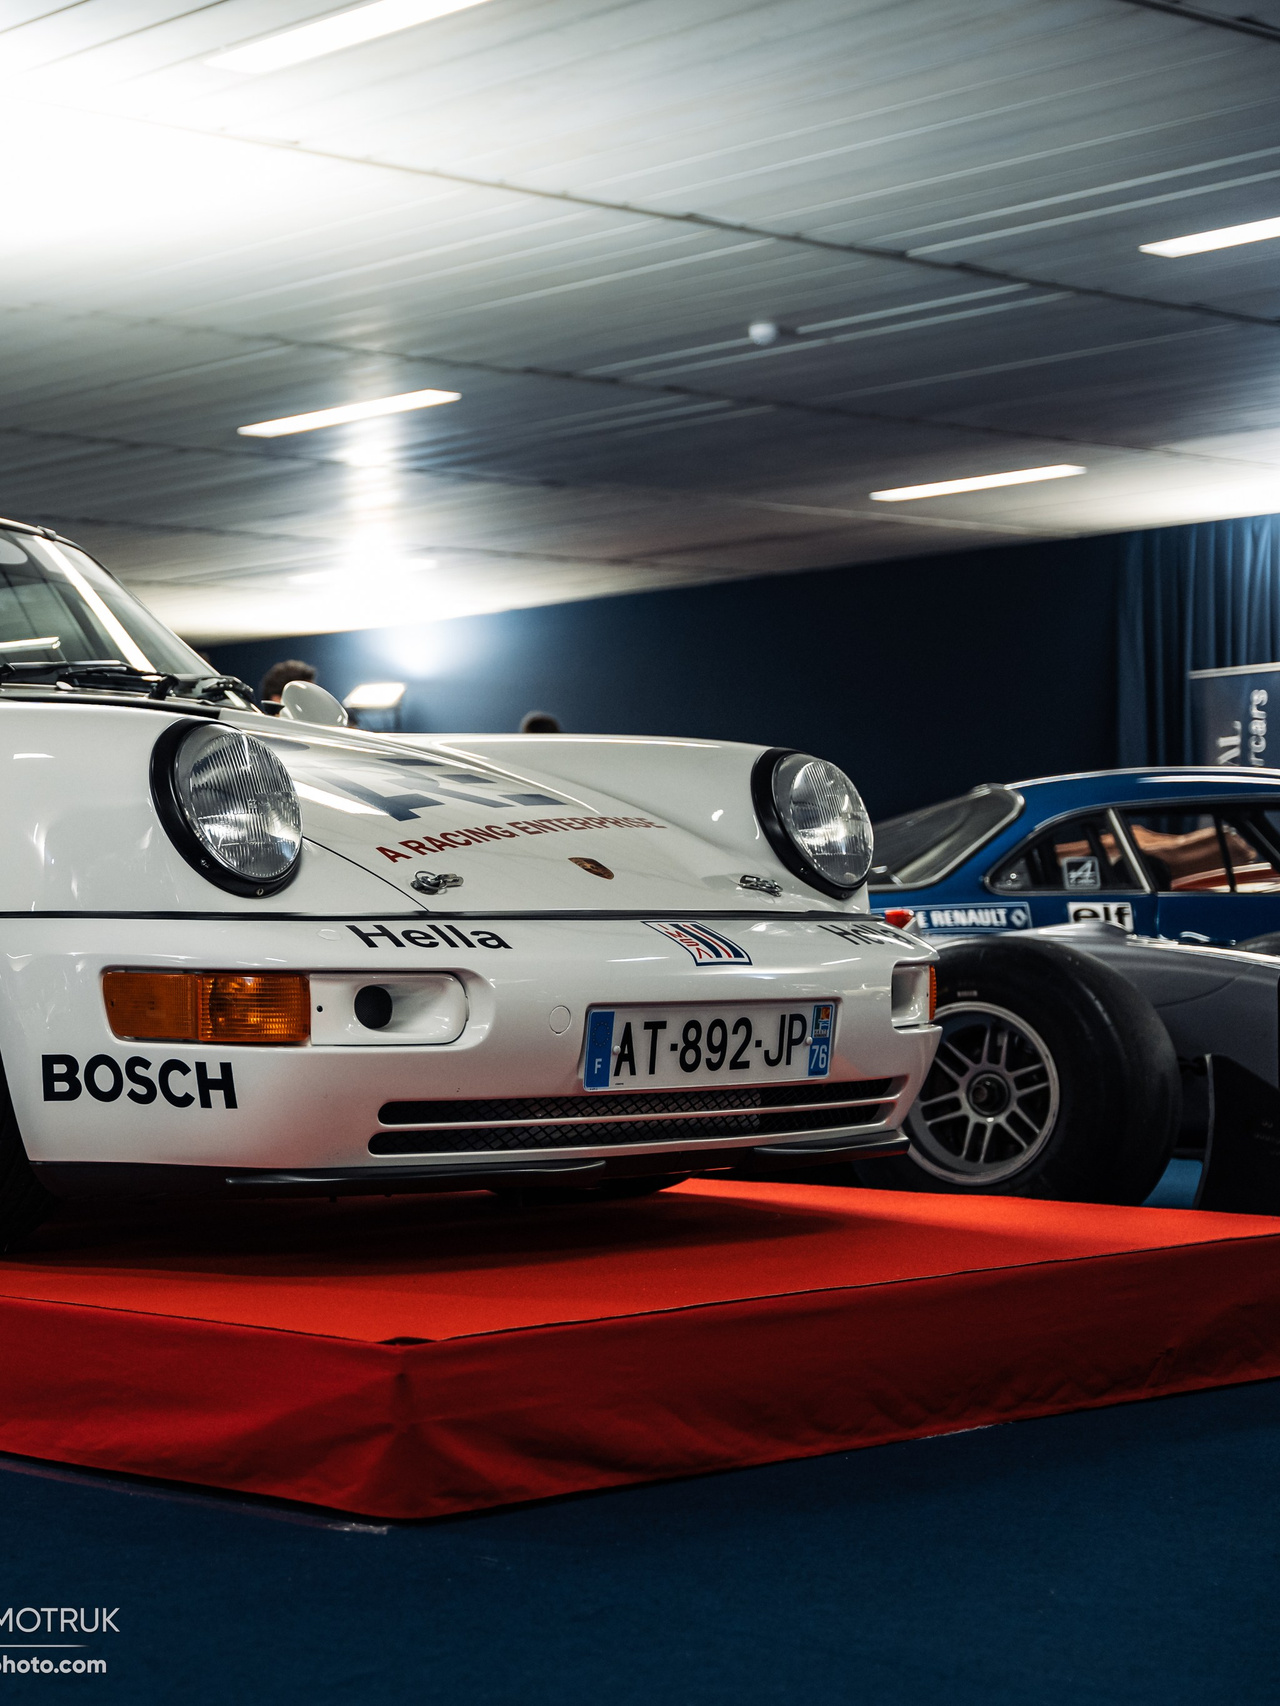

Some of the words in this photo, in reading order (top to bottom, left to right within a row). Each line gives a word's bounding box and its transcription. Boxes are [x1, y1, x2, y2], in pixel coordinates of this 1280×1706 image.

[375, 846, 413, 863] A
[398, 825, 520, 856] RACING
[506, 816, 668, 835] ENTERPRISE
[930, 908, 1008, 928] RENAULT
[1072, 905, 1132, 931] elf
[345, 924, 513, 949] Hella
[816, 923, 918, 946] Hella
[594, 1058, 602, 1074] F
[613, 1014, 808, 1077] AT-892-JP
[810, 1044, 828, 1070] 76
[41, 1054, 239, 1109] BOSCH
